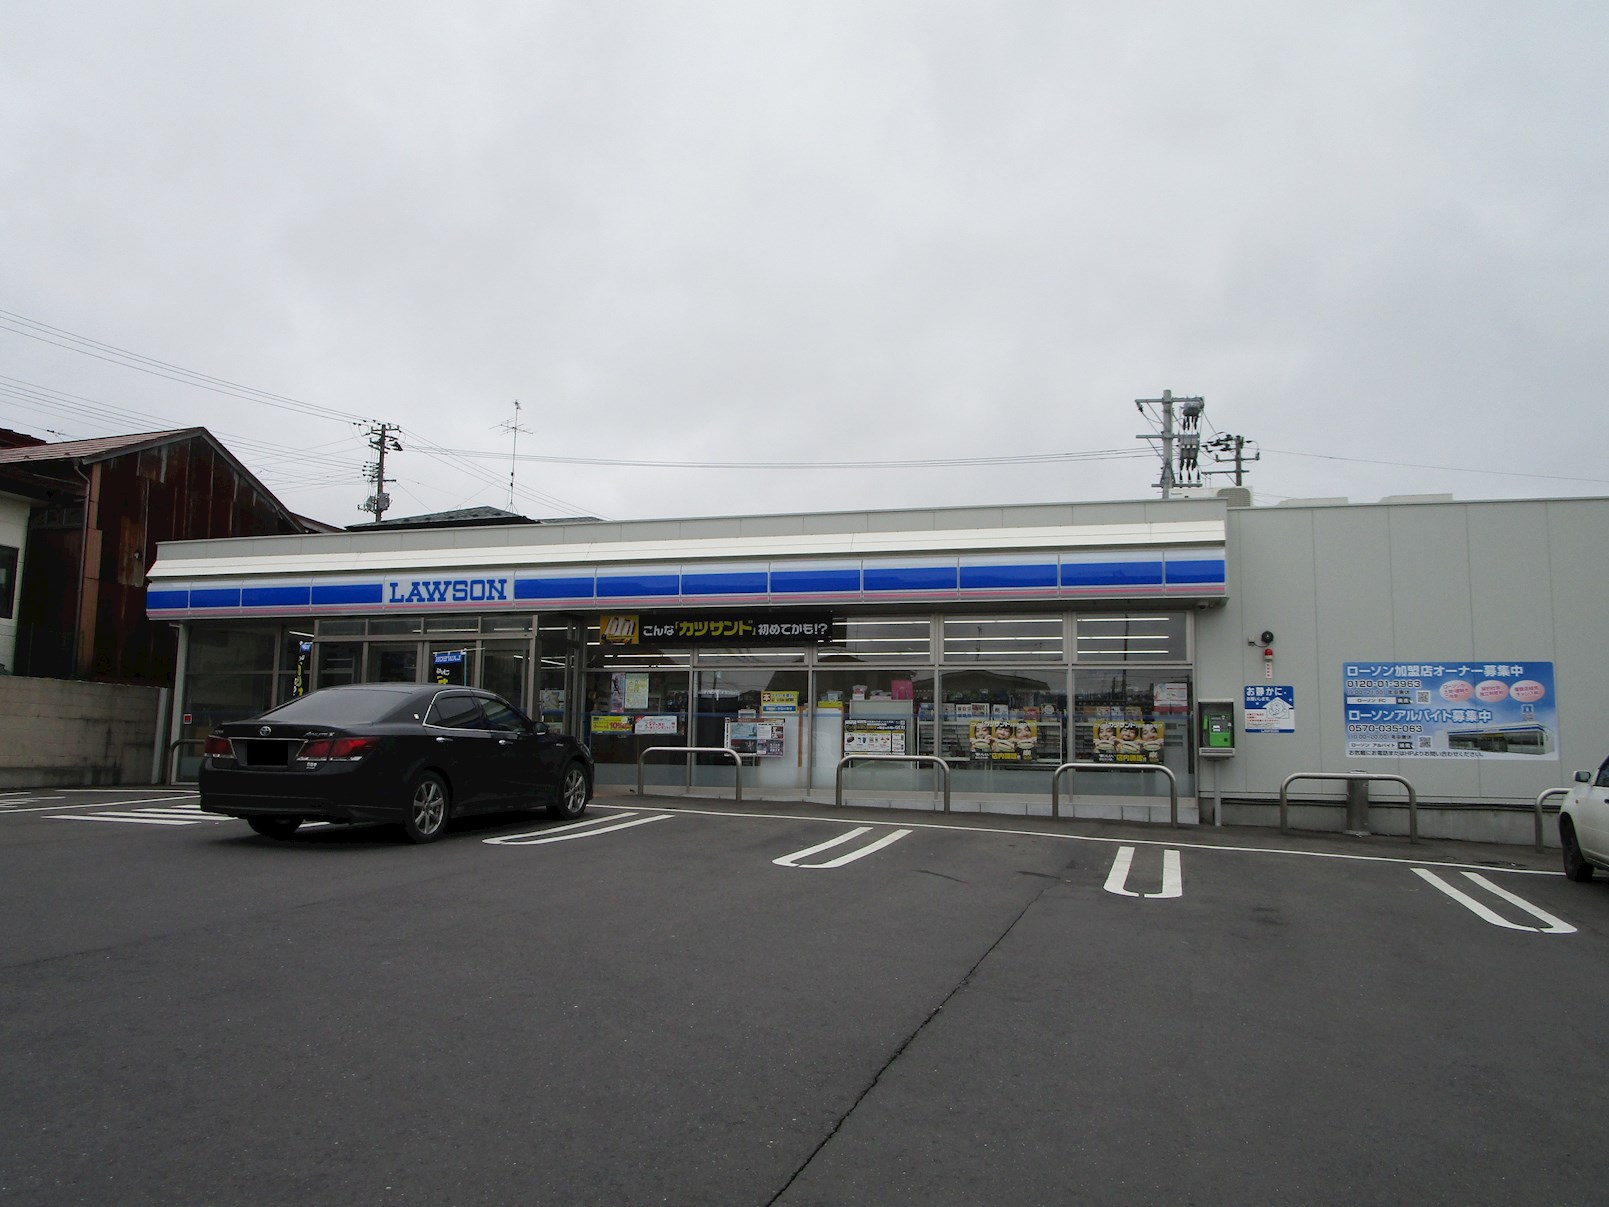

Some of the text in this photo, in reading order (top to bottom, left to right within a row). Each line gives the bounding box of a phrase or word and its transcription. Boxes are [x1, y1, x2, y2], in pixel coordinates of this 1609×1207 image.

[389, 579, 507, 603] LAWSON
[1346, 664, 1524, 678] ローソン加盟店オーナー募集中
[1346, 679, 1421, 689] 0120-01-3963
[1348, 709, 1493, 723] ローソンアルバイト募集中
[1348, 724, 1424, 733] 0570-035-063
